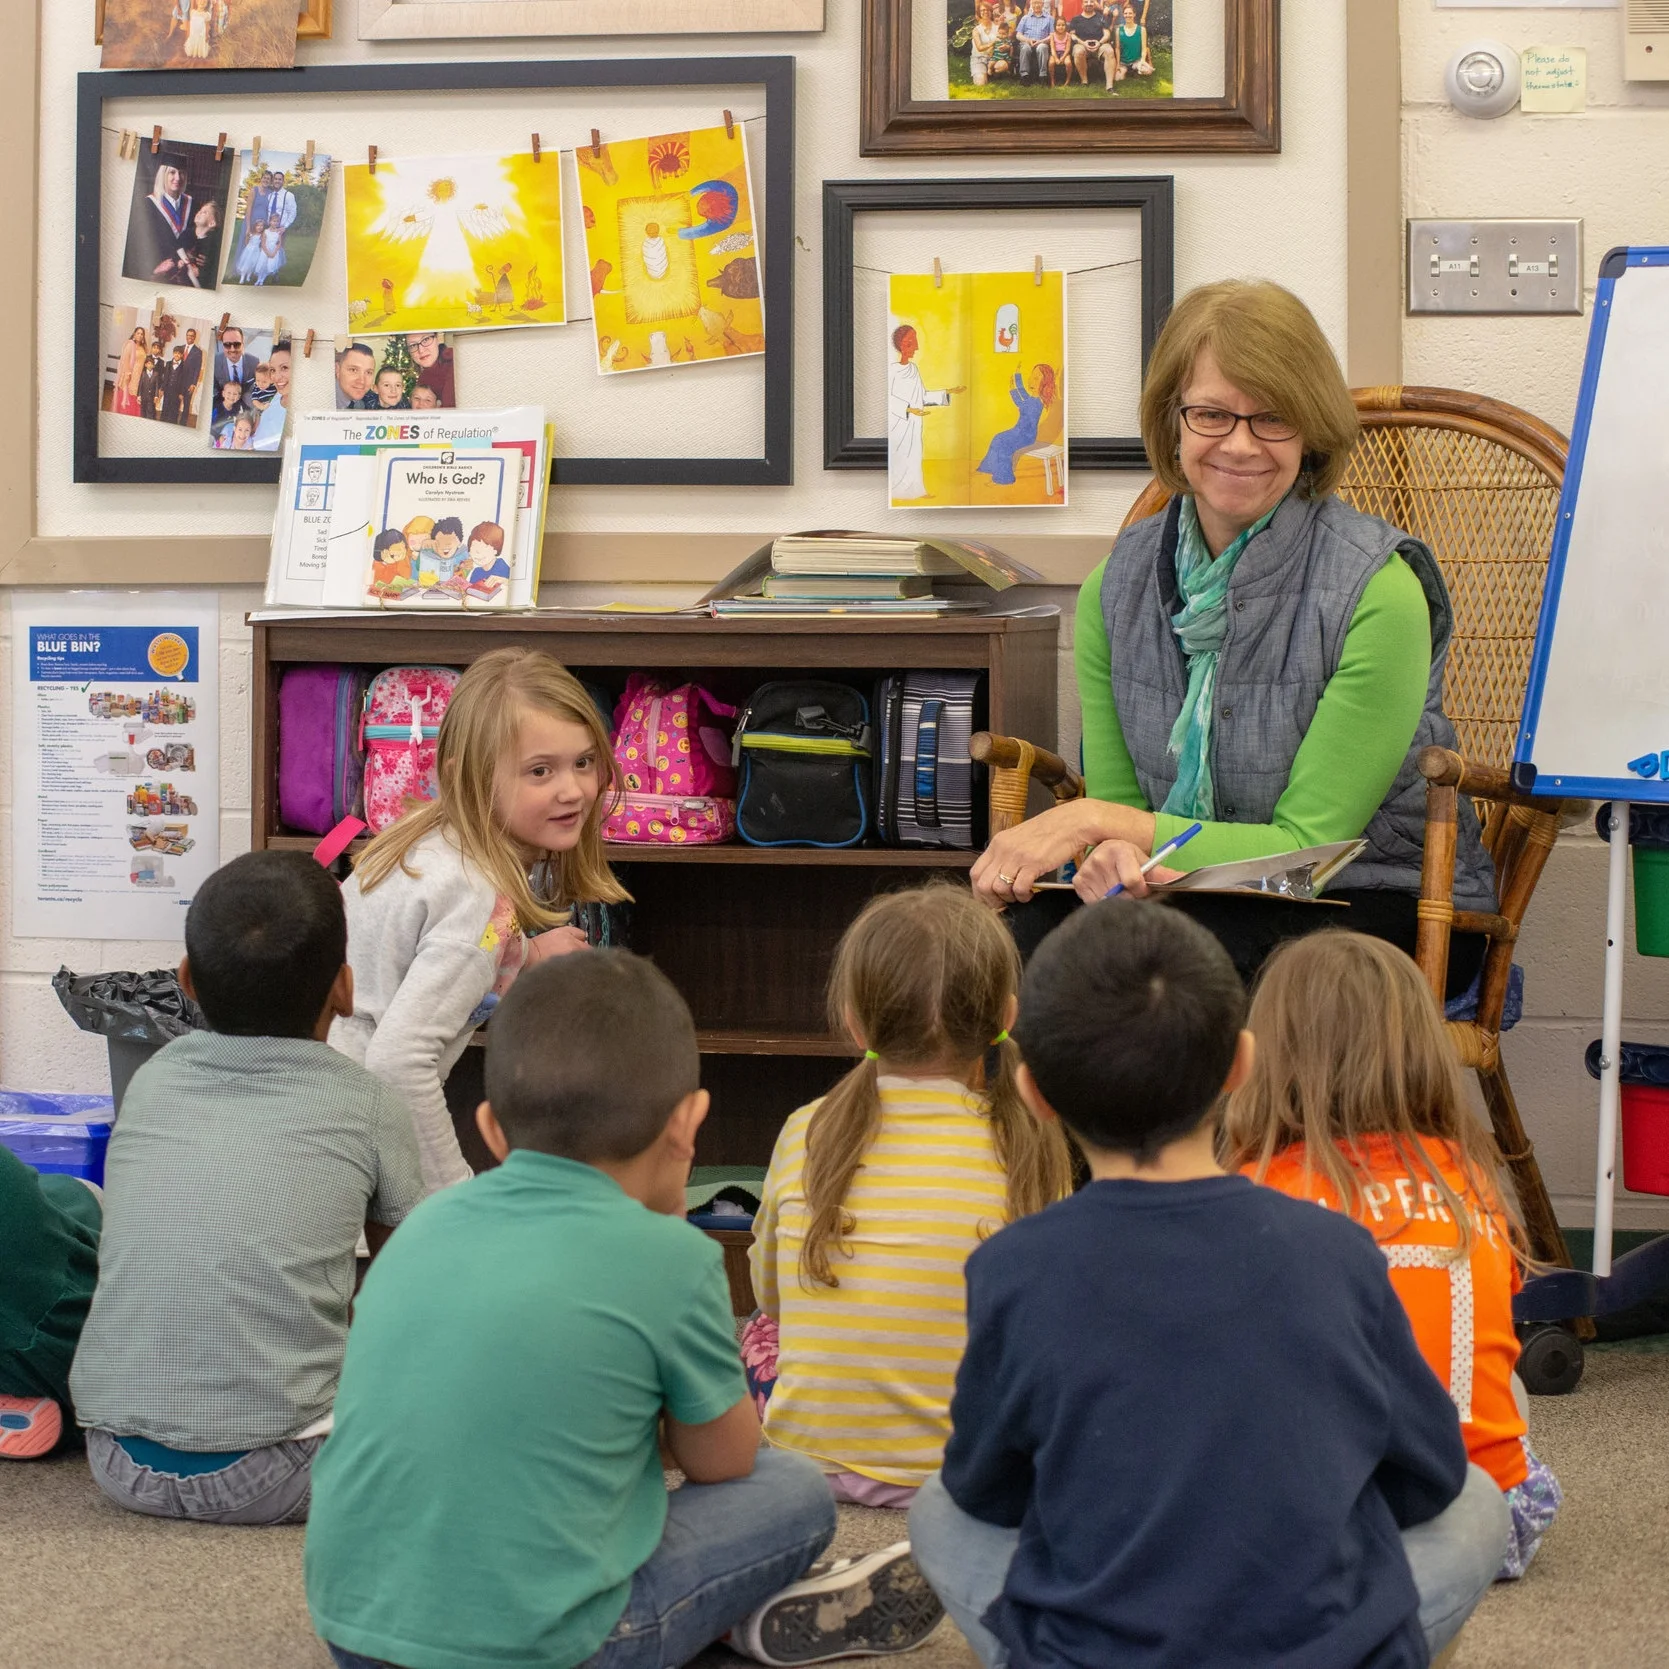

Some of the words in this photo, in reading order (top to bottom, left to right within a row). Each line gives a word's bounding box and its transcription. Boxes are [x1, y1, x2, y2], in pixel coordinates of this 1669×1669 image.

[1527, 52, 1555, 63] Please
[1559, 53, 1570, 63] do
[1525, 67, 1541, 76] not
[1546, 65, 1575, 78] adjust
[343, 429, 362, 440] The
[365, 425, 420, 440] ZONES
[423, 428, 434, 439] of
[406, 472, 435, 485] Who
[439, 473, 448, 484] Is
[452, 472, 486, 485] God?
[303, 516, 321, 524] BLUE
[37, 633, 57, 641] WHAT
[58, 633, 77, 641] GOES
[88, 633, 100, 641] THE
[37, 641, 67, 652] BLUE
[71, 641, 101, 652] BIN?
